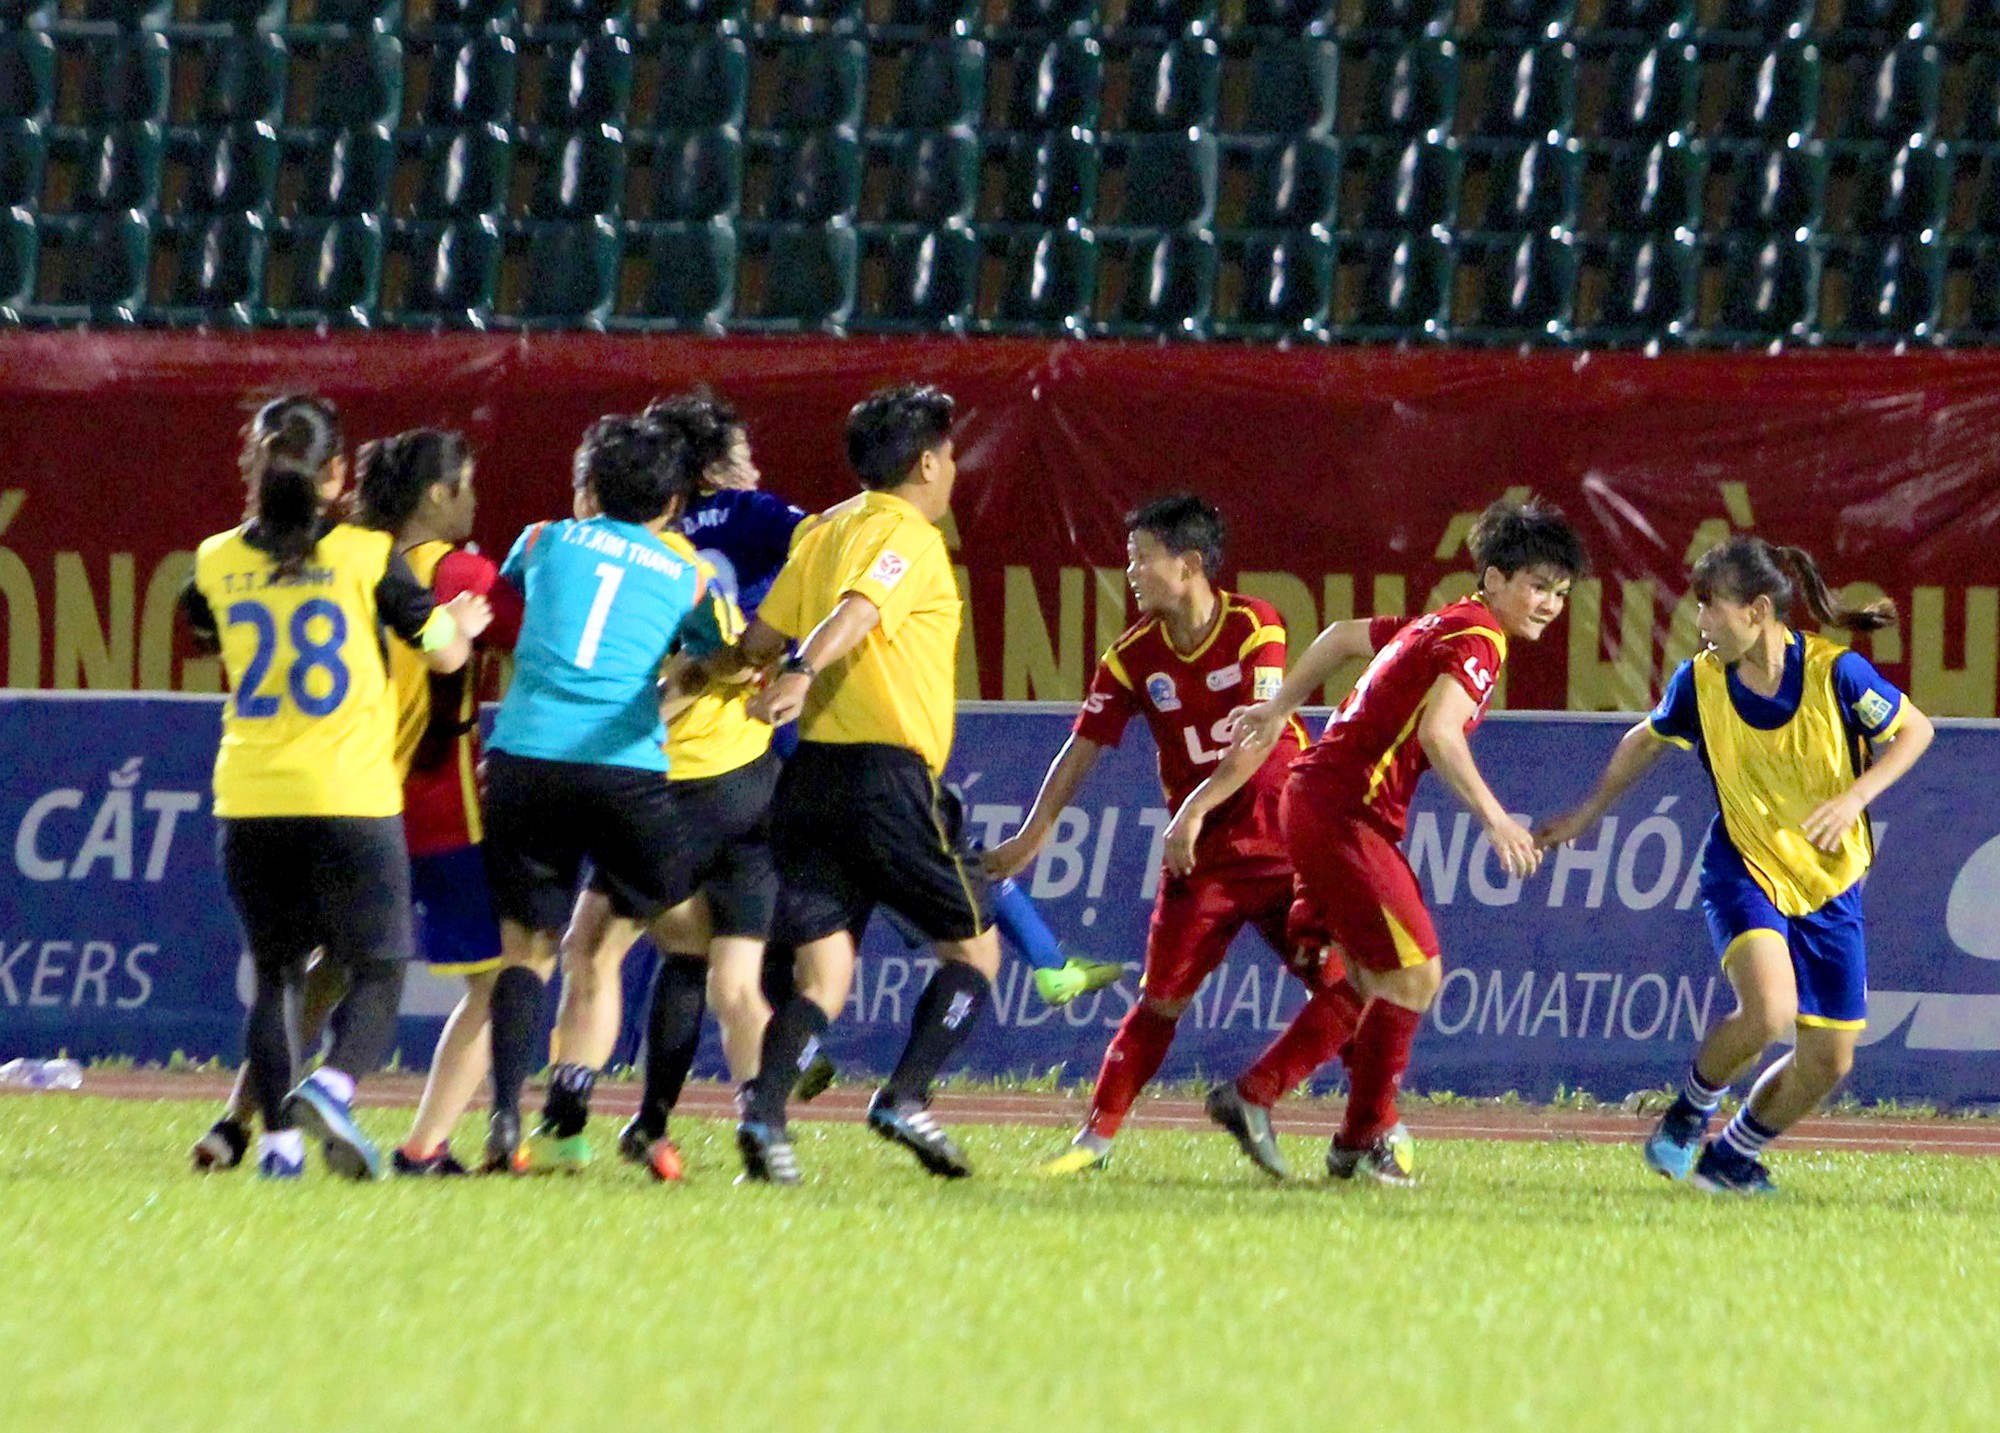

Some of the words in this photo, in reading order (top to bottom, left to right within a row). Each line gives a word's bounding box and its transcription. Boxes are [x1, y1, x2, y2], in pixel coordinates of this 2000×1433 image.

[228, 598, 350, 718] 28
[573, 562, 626, 671] 1
[14, 756, 200, 882] CẮT
[1030, 805, 1120, 927] BỊ
[1432, 967, 1716, 1042] OMATION
